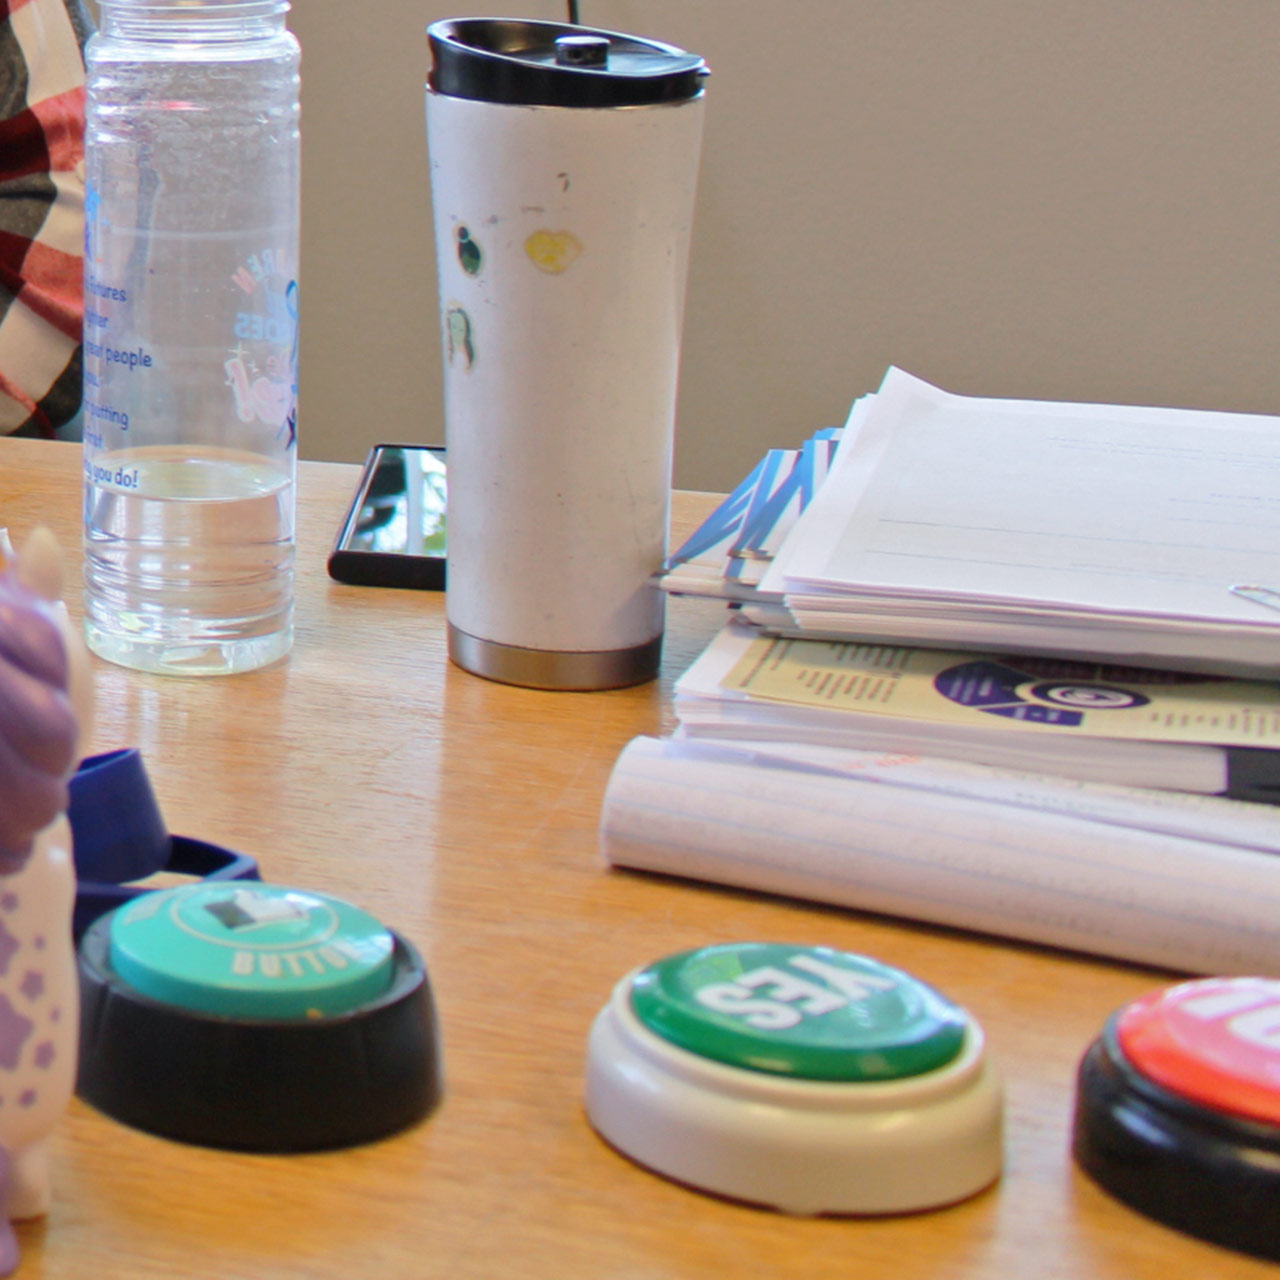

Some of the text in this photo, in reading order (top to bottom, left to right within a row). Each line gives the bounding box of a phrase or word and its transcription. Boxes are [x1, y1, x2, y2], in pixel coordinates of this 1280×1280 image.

[106, 347, 152, 372] people
[115, 468, 138, 488] do!
[695, 954, 897, 1030] YES
